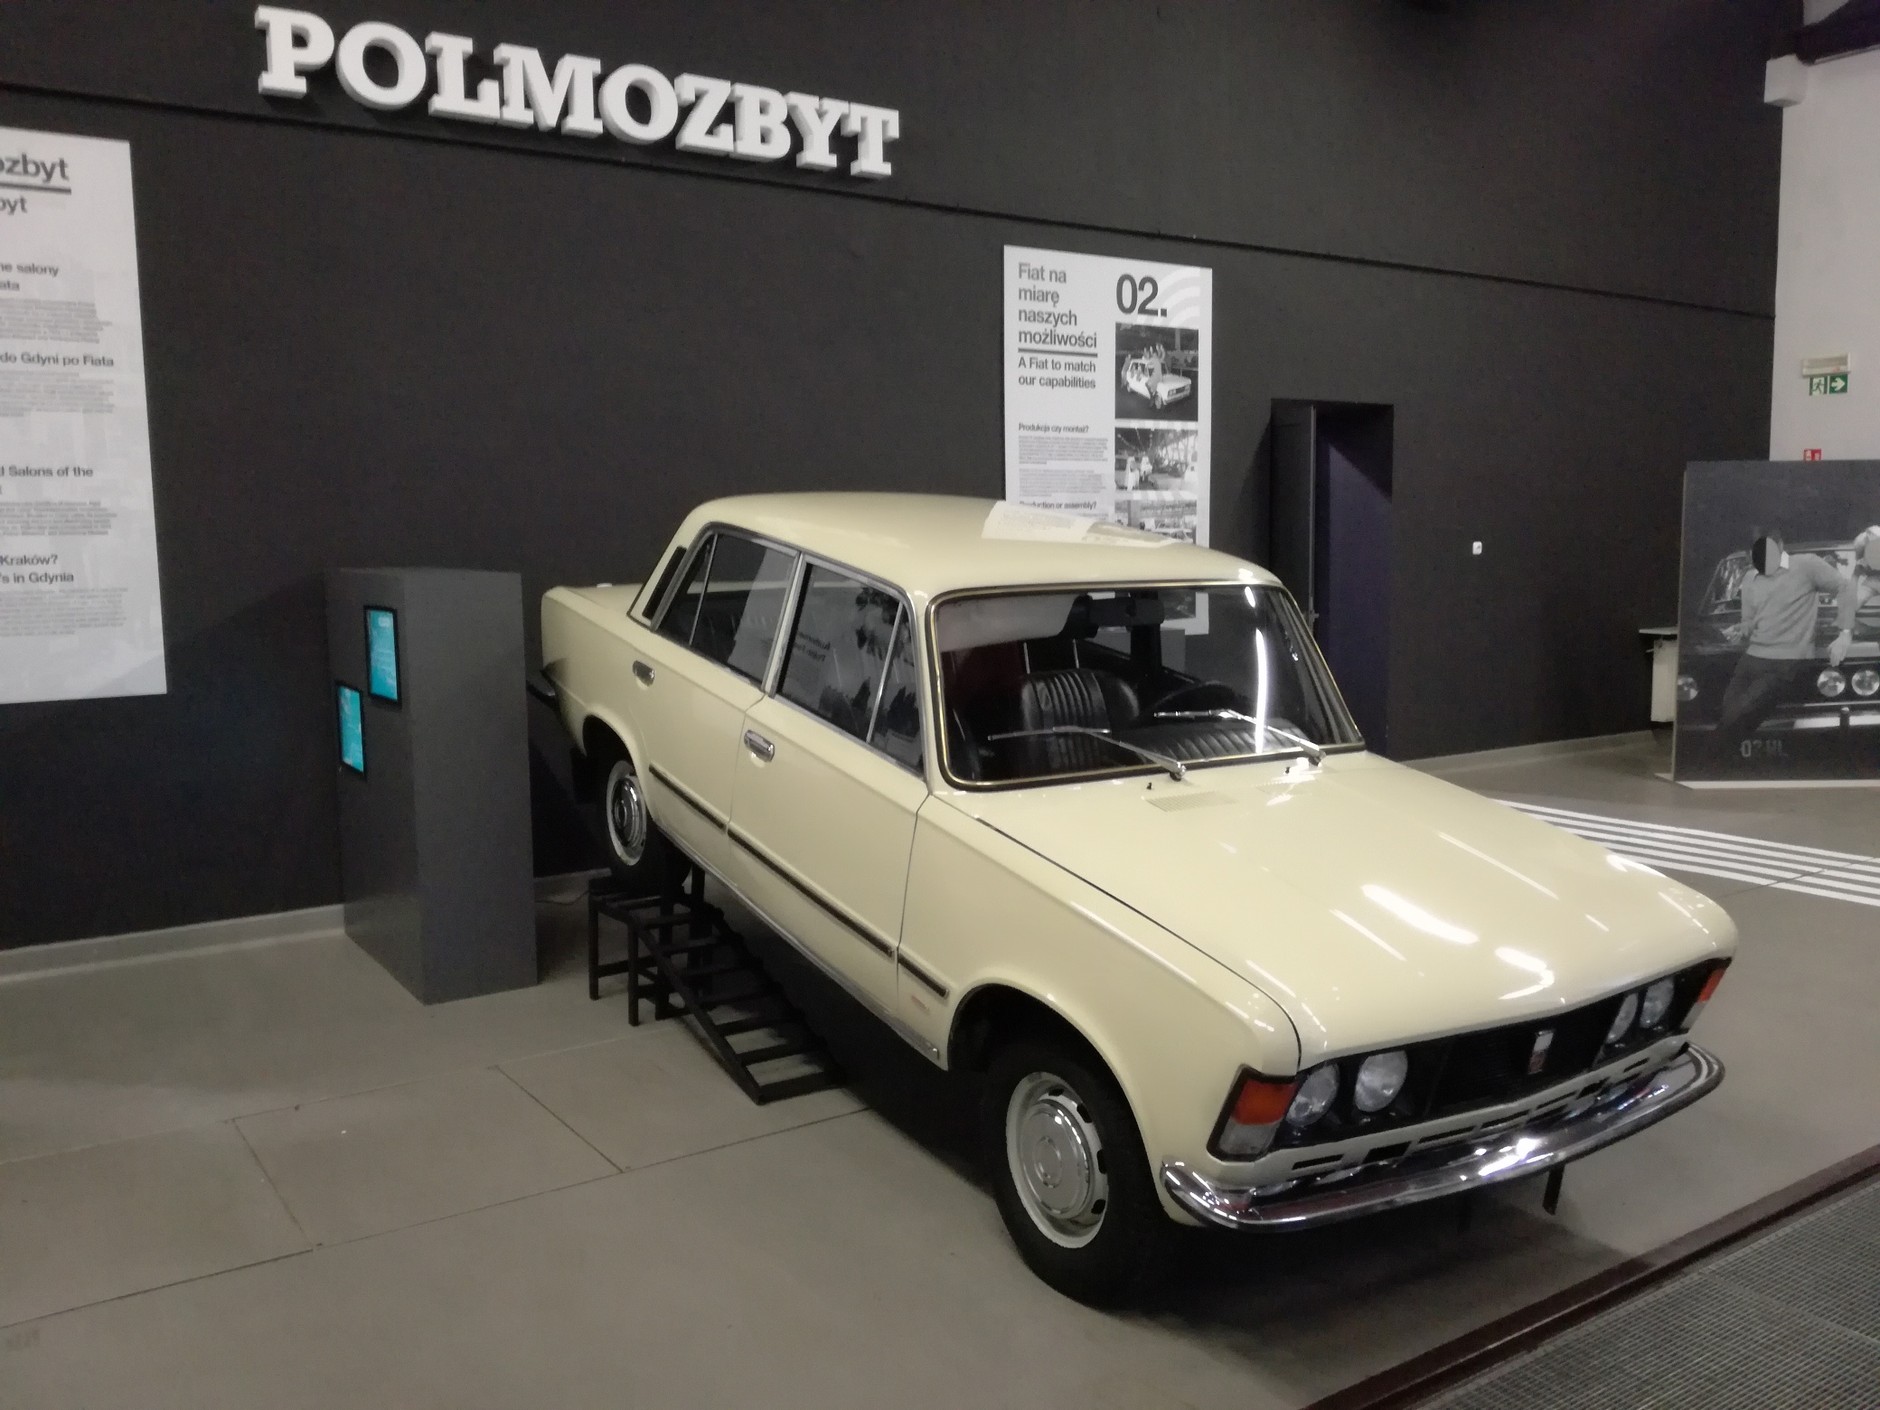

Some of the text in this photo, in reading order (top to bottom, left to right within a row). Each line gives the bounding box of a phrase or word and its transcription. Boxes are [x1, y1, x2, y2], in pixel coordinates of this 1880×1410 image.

[254, 5, 900, 178] POLMOZBYT
[16, 264, 59, 278] salony
[1018, 262, 1067, 283] Fiat na
[1018, 286, 1060, 306] miarę
[1116, 273, 1168, 317] 02.
[1018, 309, 1078, 327] naszych
[1018, 330, 1098, 348] możliwości
[20, 352, 59, 367] Gdyni
[62, 356, 80, 367] po
[83, 354, 114, 367] Fiata
[1018, 356, 1096, 373] A Fiat to match
[1018, 375, 1096, 390] our capabilities
[9, 465, 53, 477] Salons
[57, 466, 69, 477] of
[73, 466, 93, 477] the
[0, 554, 58, 566] Kraków?
[14, 573, 25, 583] in
[29, 572, 74, 585] Gdynia
